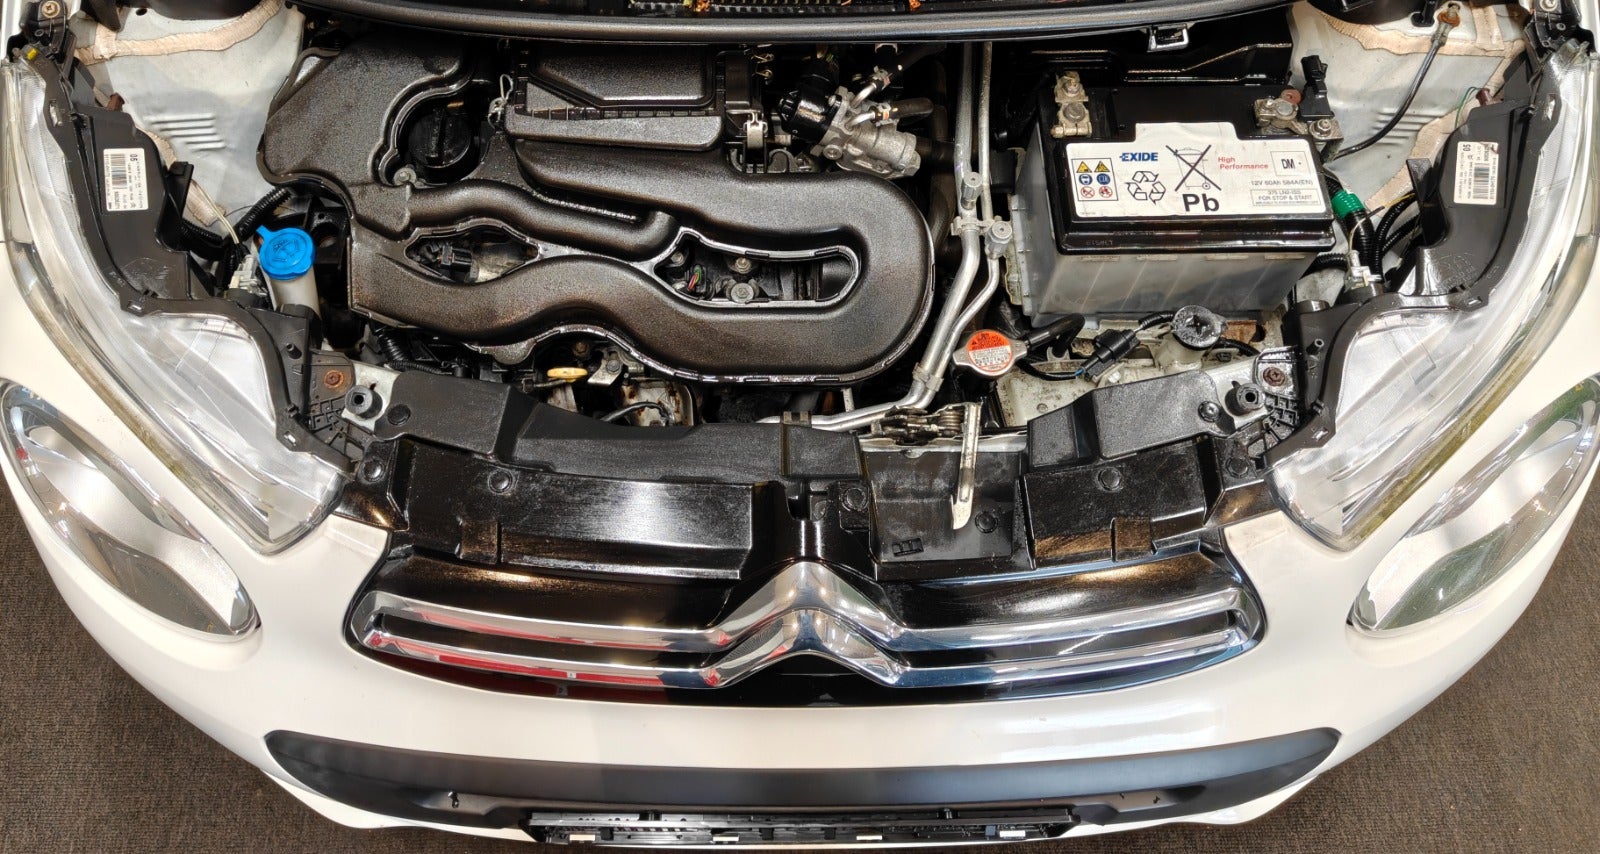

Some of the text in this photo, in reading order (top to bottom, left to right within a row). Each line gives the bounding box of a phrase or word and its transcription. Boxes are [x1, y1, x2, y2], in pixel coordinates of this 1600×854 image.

[1462, 144, 1471, 152] 05
[1119, 152, 1158, 162] EXIDE
[1281, 158, 1295, 169] DM
[1182, 193, 1220, 212] Pb
